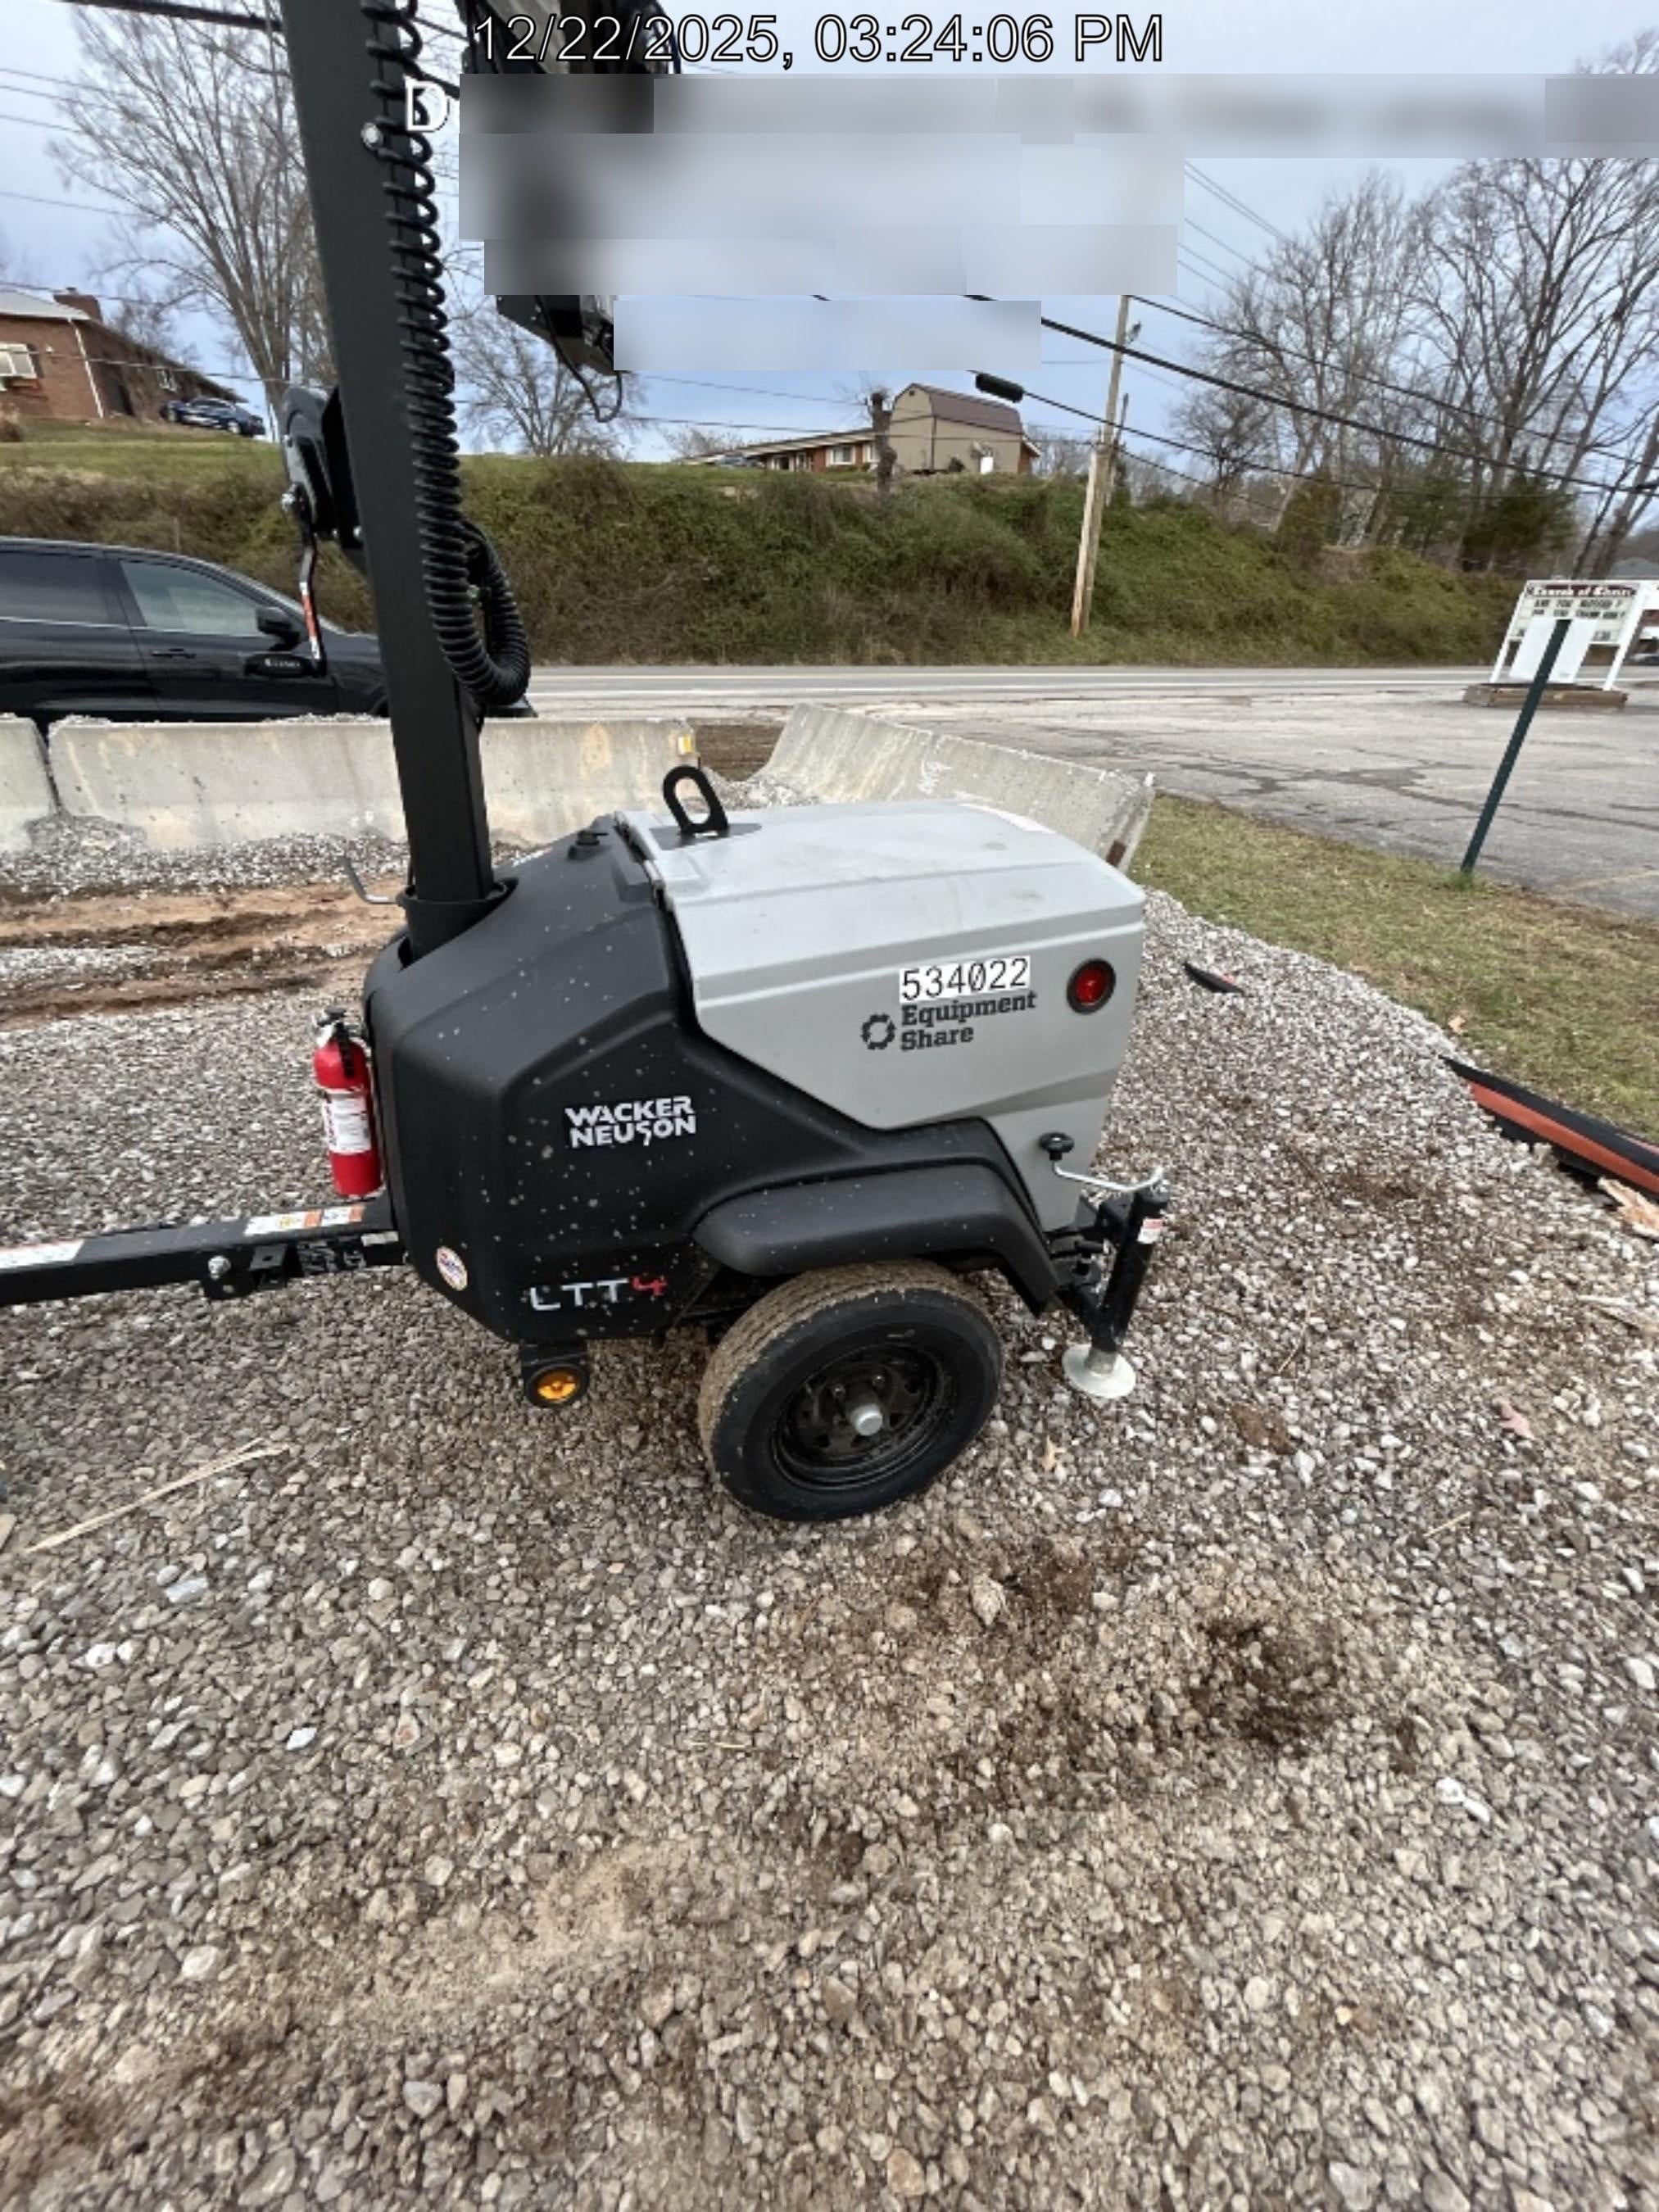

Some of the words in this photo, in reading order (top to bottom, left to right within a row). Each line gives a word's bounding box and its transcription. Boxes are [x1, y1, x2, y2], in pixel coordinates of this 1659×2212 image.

[901, 957, 1029, 1000] 534022
[900, 990, 1037, 1028] Equipment
[900, 1026, 975, 1051] Share
[564, 1095, 695, 1127] WACKER
[569, 1115, 696, 1148] NEUSON
[529, 1275, 669, 1312] LTT4
